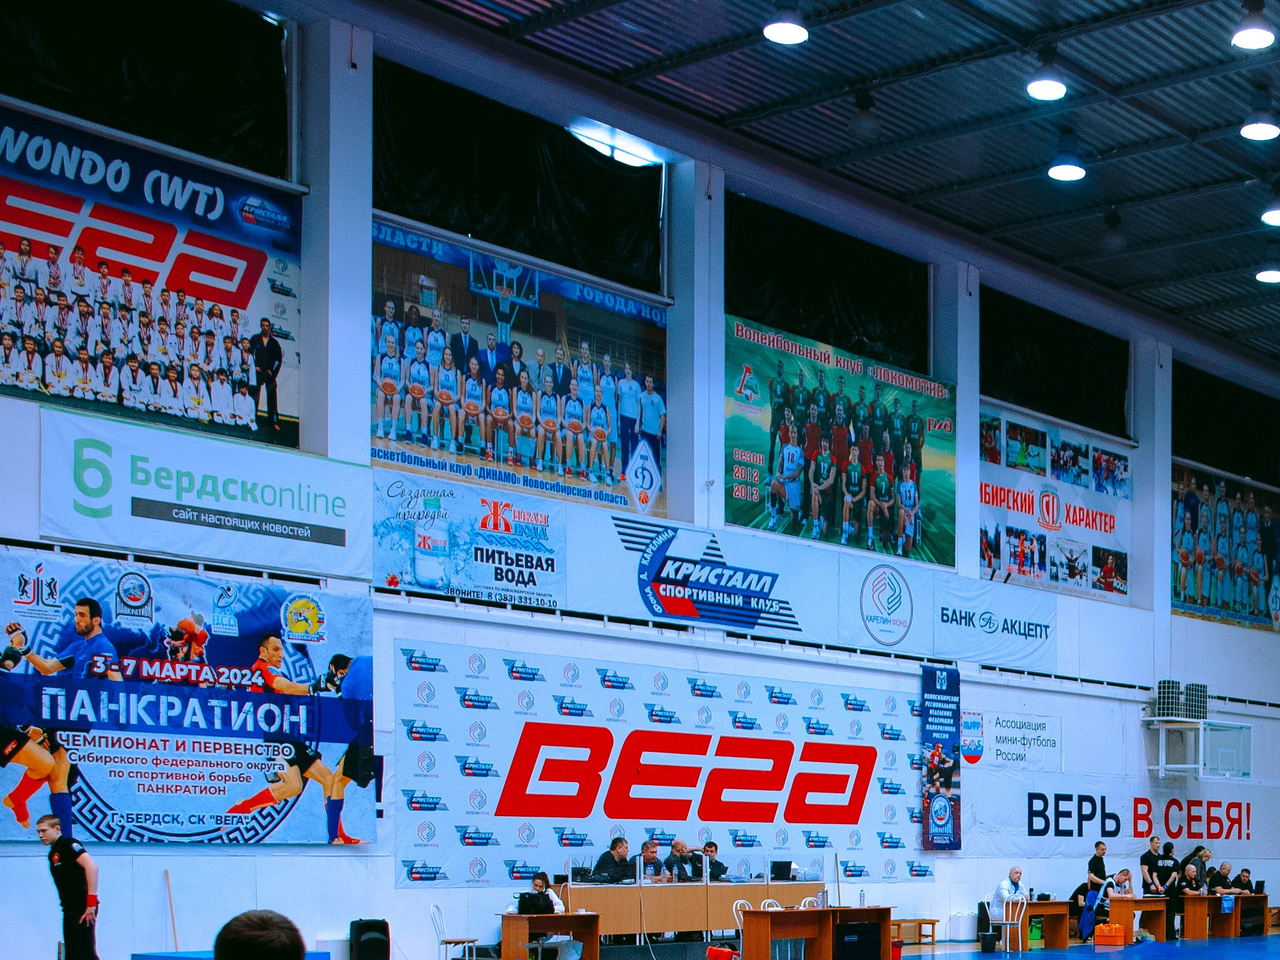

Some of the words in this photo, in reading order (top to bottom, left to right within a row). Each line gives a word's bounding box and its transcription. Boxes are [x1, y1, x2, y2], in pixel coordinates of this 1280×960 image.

[144, 169, 225, 221] (WT)
[735, 321, 832, 365] Волейбольный
[835, 355, 864, 376] клуб
[733, 448, 765, 466] сезон
[450, 460, 473, 477] клуб
[522, 475, 592, 499] Новосибирская
[594, 488, 629, 506] область
[733, 465, 759, 483] 2012
[733, 484, 759, 502] 2013
[172, 507, 199, 522] сайт
[201, 512, 261, 531] настоящих
[262, 521, 311, 538] новостей
[1065, 503, 1116, 534] ХАРАКТЕР
[474, 547, 556, 573] ПИТЬЕВАЯ
[494, 566, 538, 588] ВОДА
[660, 560, 773, 593] КРИСТАЛЛ
[444, 587, 484, 600] ЗВОНИТЕ!
[487, 593, 493, 601] 8
[495, 593, 516, 604] (383)
[517, 596, 558, 608] 331-10-10
[659, 584, 744, 607] СПОРТИВНЫЙ
[751, 597, 780, 613] КЛУБ
[940, 606, 976, 628] БАНК
[1001, 618, 1050, 640] АКЦЕПТ
[93, 656, 106, 673] 3
[123, 658, 136, 676] 7
[142, 659, 215, 683] МАРТА
[217, 666, 265, 687] 2024
[41, 686, 308, 735] ПАНКРАТИОН
[995, 716, 1047, 732] Ассоциация
[58, 733, 171, 752] ЧЕМПИОНАТ
[175, 739, 186, 752] И
[192, 740, 294, 758] ПЕРВЕНСТВО
[995, 733, 1057, 749] мини-футбола
[69, 752, 148, 765] Сибирского
[151, 755, 244, 770] федерального
[247, 761, 286, 773] округа
[995, 748, 1027, 762] России
[109, 769, 126, 779] по
[128, 770, 206, 783] спортивной
[209, 772, 252, 784] борьбе
[137, 783, 227, 796] ПАНКРАТИОН
[188, 814, 207, 826] СК
[1027, 792, 1122, 838] ВЕРЬ
[1133, 797, 1153, 839] В
[1164, 798, 1252, 840] СЕБЯ!
